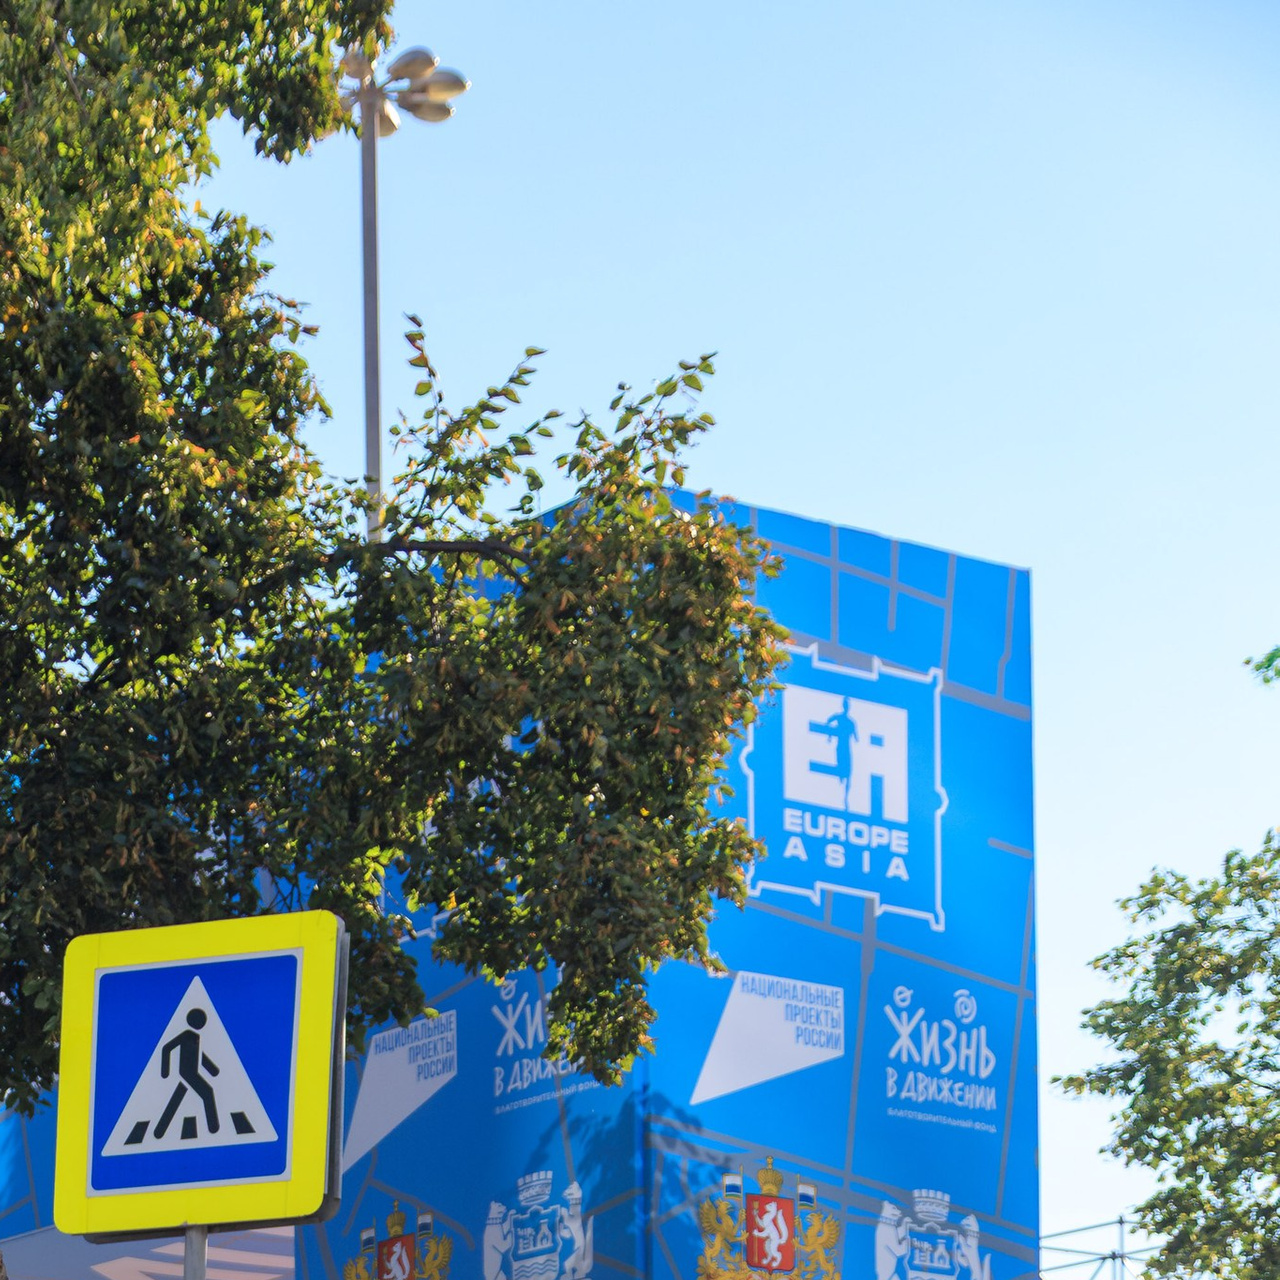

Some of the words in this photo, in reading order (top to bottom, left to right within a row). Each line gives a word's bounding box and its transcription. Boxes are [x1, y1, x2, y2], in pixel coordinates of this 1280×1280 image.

[783, 684, 909, 824] EA
[783, 808, 909, 855] EUROPE
[783, 836, 910, 881] ASIA
[740, 975, 841, 1009] НАЦИОНАЛЬНЫЕ
[375, 1013, 455, 1055] НАЦИОНАЛЬНЫЕ
[785, 1003, 841, 1029] ПРОЕКТЫ
[408, 1035, 455, 1064] ПРОЕКТЫ
[796, 1026, 842, 1051] РОССИИ
[884, 1004, 996, 1080] ЖИЗНЬ
[417, 1055, 455, 1082] РОССИИ
[495, 1066, 505, 1097] В
[886, 1067, 898, 1098] В
[901, 1077, 997, 1111] ДВИЖЕНИИ
